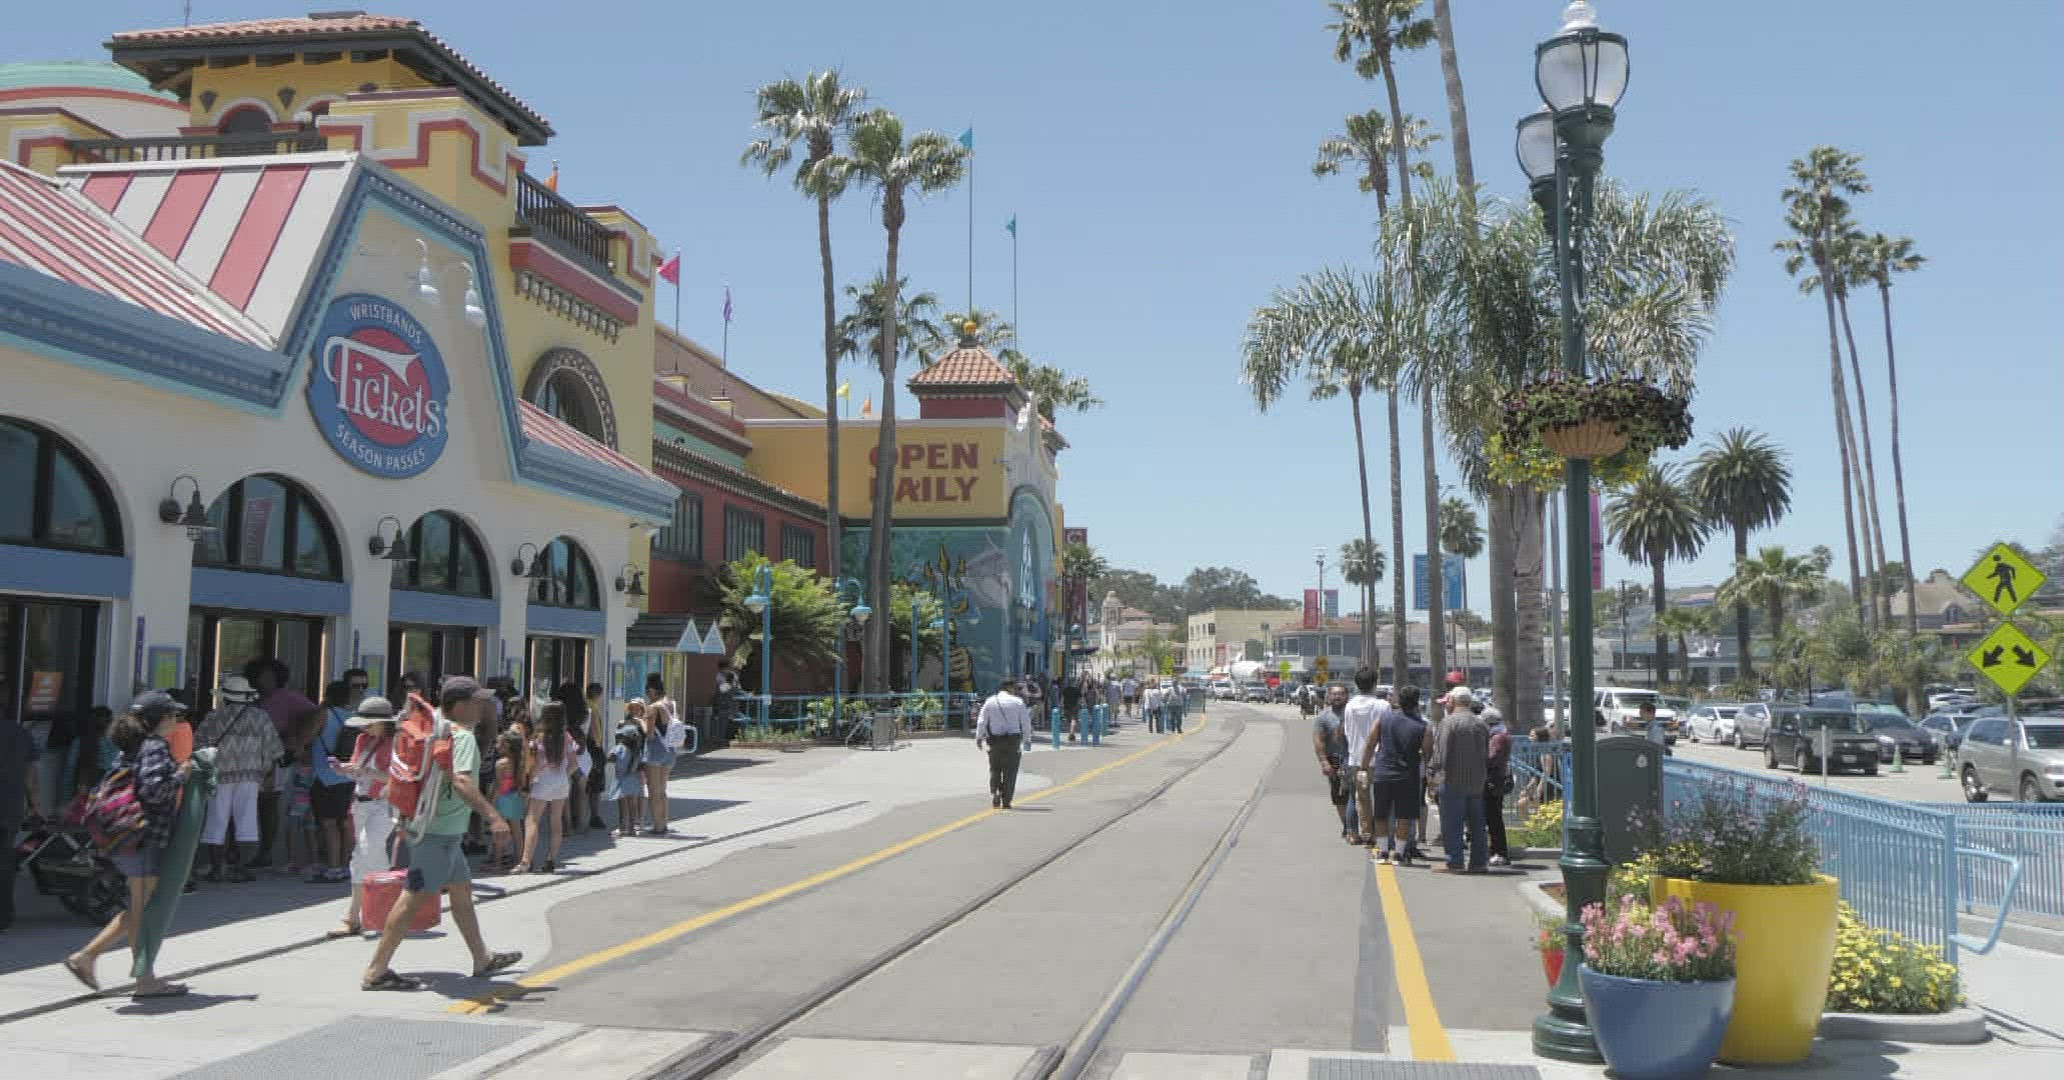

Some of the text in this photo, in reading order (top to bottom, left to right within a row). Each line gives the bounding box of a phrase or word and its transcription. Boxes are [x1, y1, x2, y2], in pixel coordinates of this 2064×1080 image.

[351, 303, 422, 345] WRISTBANDS
[322, 336, 440, 438] Tickets
[335, 424, 426, 472] SEASON PASSES
[869, 476, 979, 502] AILY
